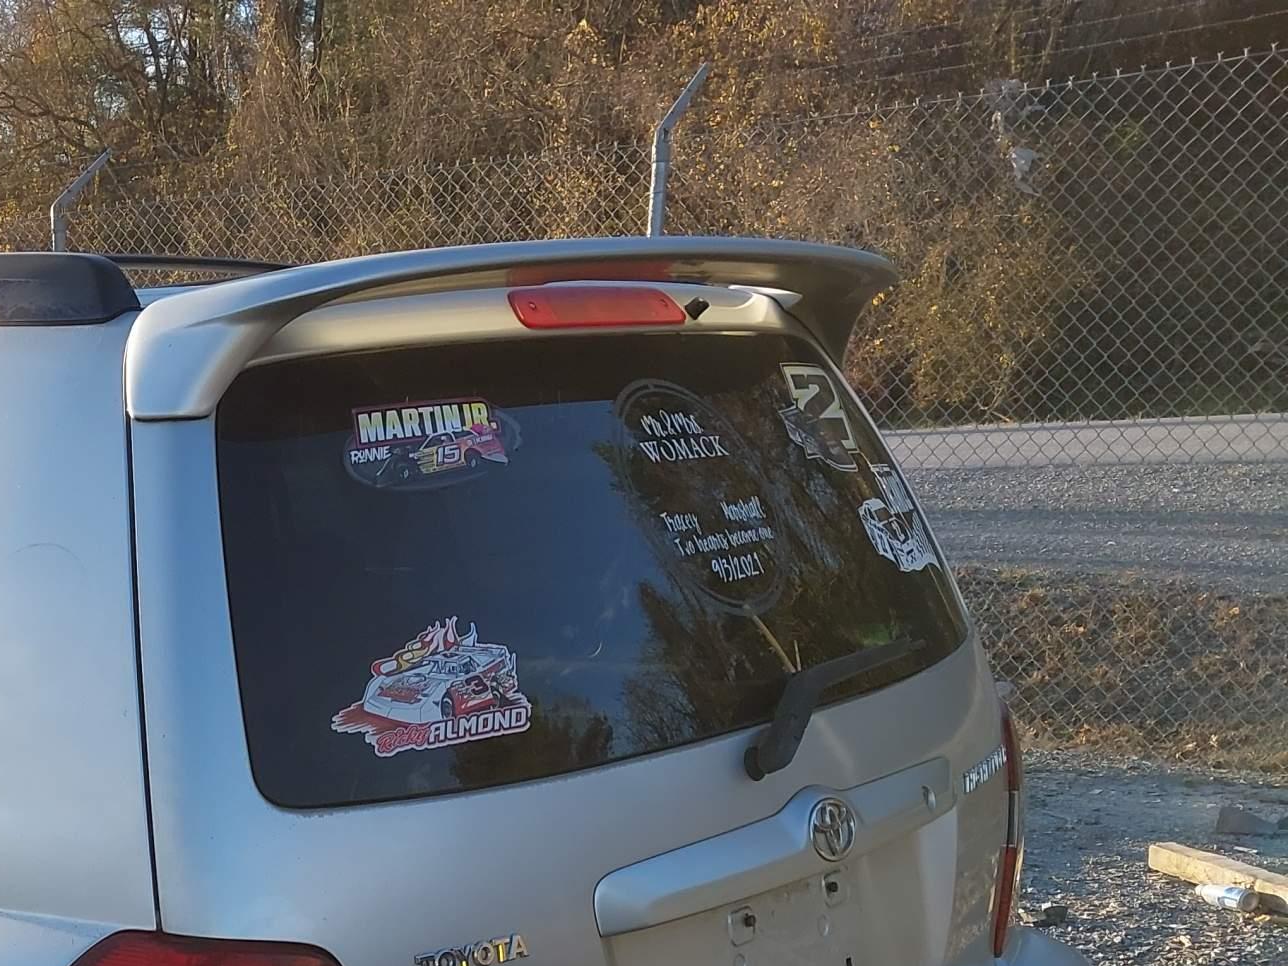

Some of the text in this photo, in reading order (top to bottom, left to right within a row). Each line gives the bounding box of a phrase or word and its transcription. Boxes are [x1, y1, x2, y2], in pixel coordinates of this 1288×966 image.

[357, 402, 498, 444] MARTIN JR.
[350, 445, 392, 465] RONNIE
[435, 444, 461, 465] 15
[640, 435, 730, 463] WOMACK
[659, 511, 702, 535] Tracey
[693, 532, 729, 552] hearts
[724, 528, 759, 548] become
[711, 551, 765, 583] 9/3/2021
[464, 674, 489, 696] 3
[377, 707, 529, 754] Ricky ALMOND
